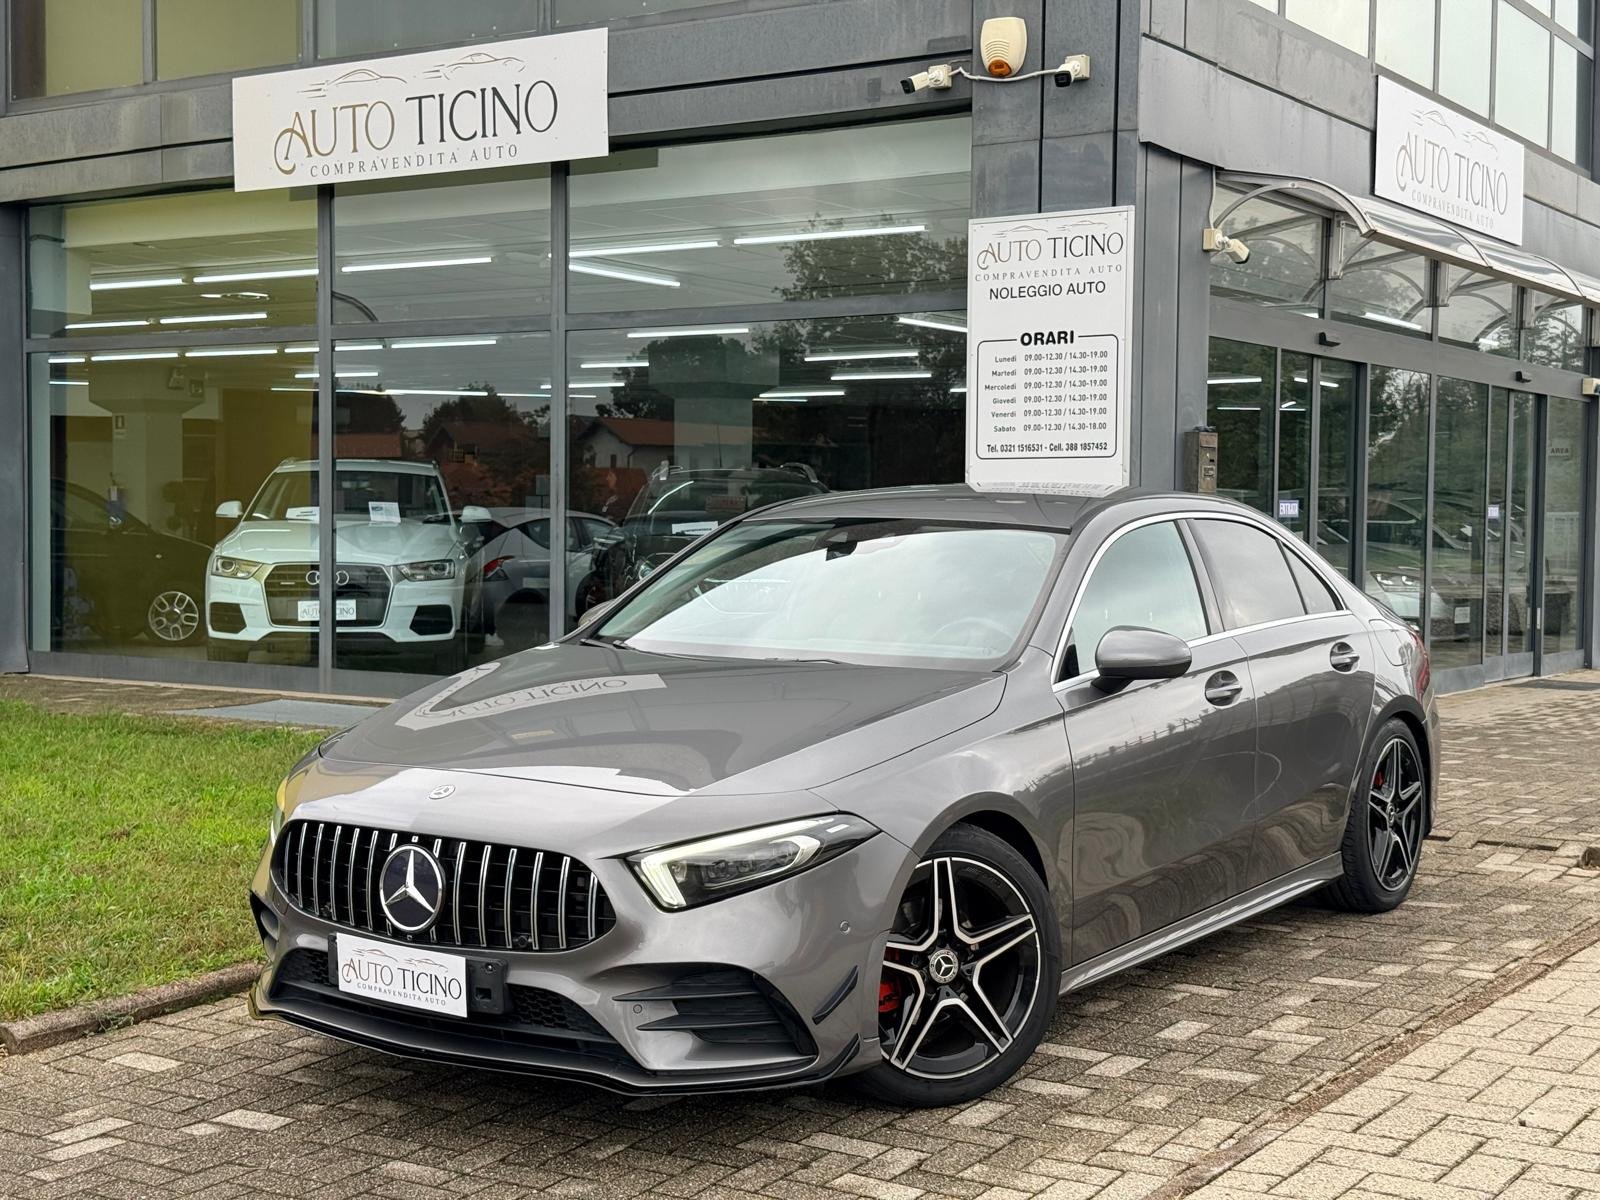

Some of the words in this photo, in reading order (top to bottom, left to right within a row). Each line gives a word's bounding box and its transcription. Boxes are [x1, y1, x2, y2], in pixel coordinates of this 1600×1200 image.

[274, 101, 395, 175] AUTO
[405, 80, 558, 145] TICINO
[310, 151, 459, 178] COMPRAVENDITA
[470, 144, 518, 161] AUTO
[1396, 131, 1450, 192] AUTO
[1454, 152, 1508, 216] TICINO
[1411, 189, 1472, 220] COMPRAVENDITA
[977, 239, 1042, 270] AUTO
[1047, 232, 1124, 258] TICINO
[975, 267, 1081, 282] COMPRAVENDITA
[1088, 264, 1123, 274] AUTO
[989, 283, 1063, 300] NOLEGGIO
[1066, 280, 1106, 295] AUTO
[1020, 330, 1075, 346] ORARI
[993, 425, 1016, 433] Sabato
[986, 444, 998, 453] Tel.
[1000, 444, 1016, 452] 0321
[1017, 443, 1043, 452] 1516531
[1049, 443, 1064, 452] Cell.
[1065, 442, 1078, 451] 388
[1080, 442, 1108, 451] 1857452
[342, 958, 394, 986] AUTO
[398, 967, 462, 1000] TICINO
[357, 982, 422, 1000] COMPRAVENDITA
[425, 998, 446, 1006] AUTO
